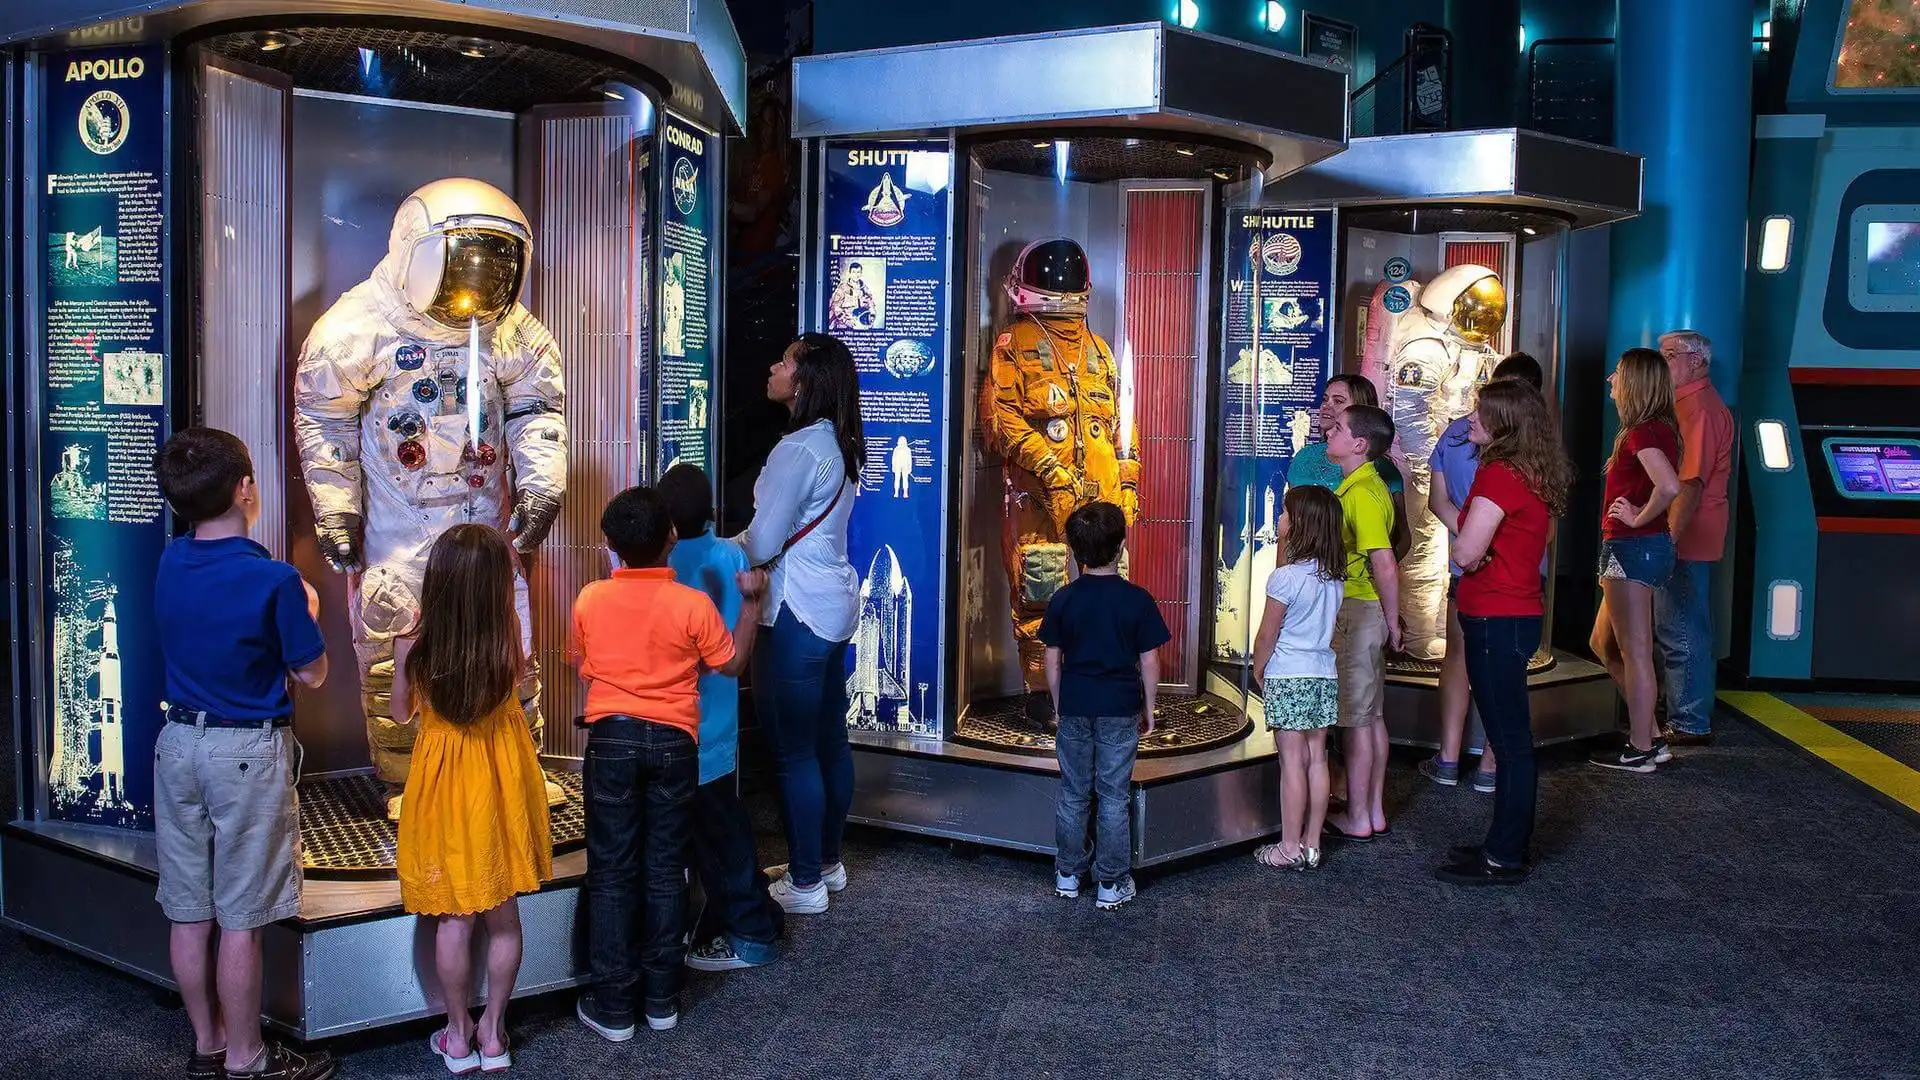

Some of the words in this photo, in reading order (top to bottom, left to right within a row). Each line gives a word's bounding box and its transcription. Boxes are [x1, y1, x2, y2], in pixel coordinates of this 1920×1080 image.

[65, 57, 144, 82] APOLLO
[86, 92, 112, 108] APOLLO
[666, 125, 703, 156] CONRAD
[848, 150, 928, 166] SHUTT
[674, 176, 694, 194] NASA
[1390, 266, 1404, 276] 124
[1389, 302, 1404, 310] 312
[398, 353, 424, 363] NASA
